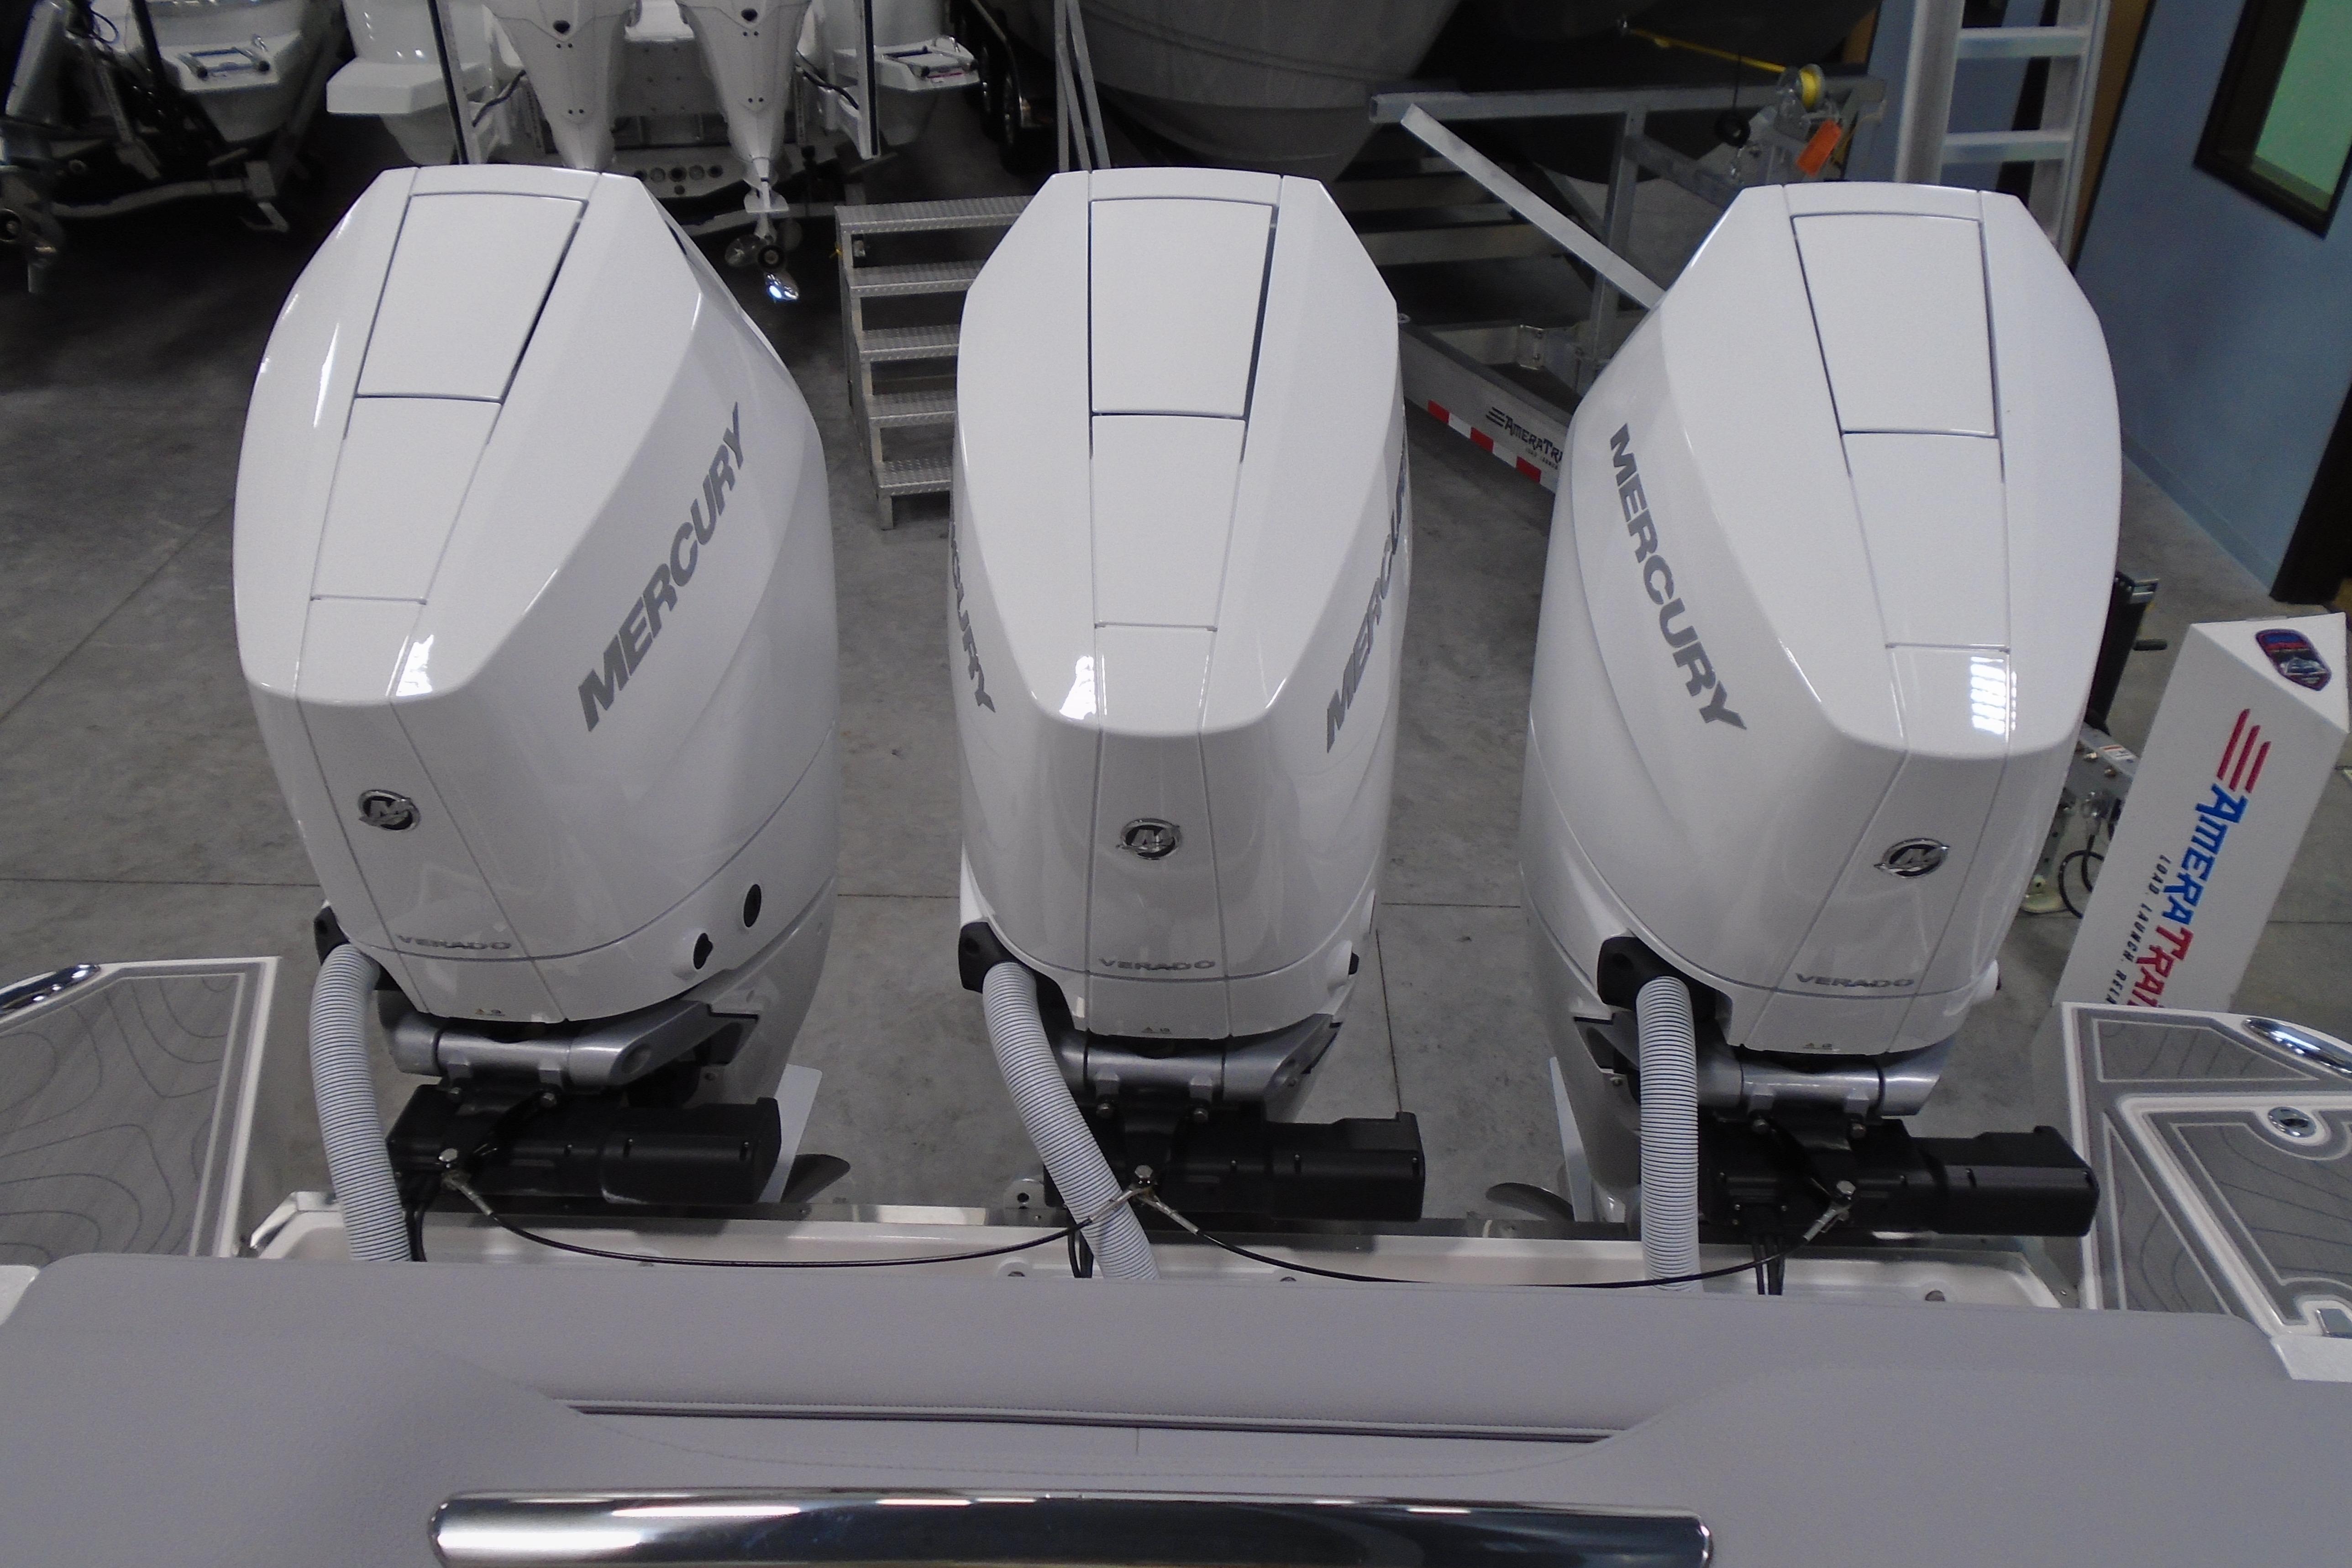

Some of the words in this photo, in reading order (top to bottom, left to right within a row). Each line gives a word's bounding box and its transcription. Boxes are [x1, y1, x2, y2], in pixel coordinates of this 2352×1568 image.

[578, 401, 743, 732] MERCURY
[950, 520, 996, 713] CURY
[1610, 423, 1747, 730] MERCURY
[1098, 958, 1215, 970] VERADO
[1796, 973, 1915, 987] VERADO
[2105, 970, 2127, 1005] RELA
[2126, 783, 2249, 1007] AMERATRAI
